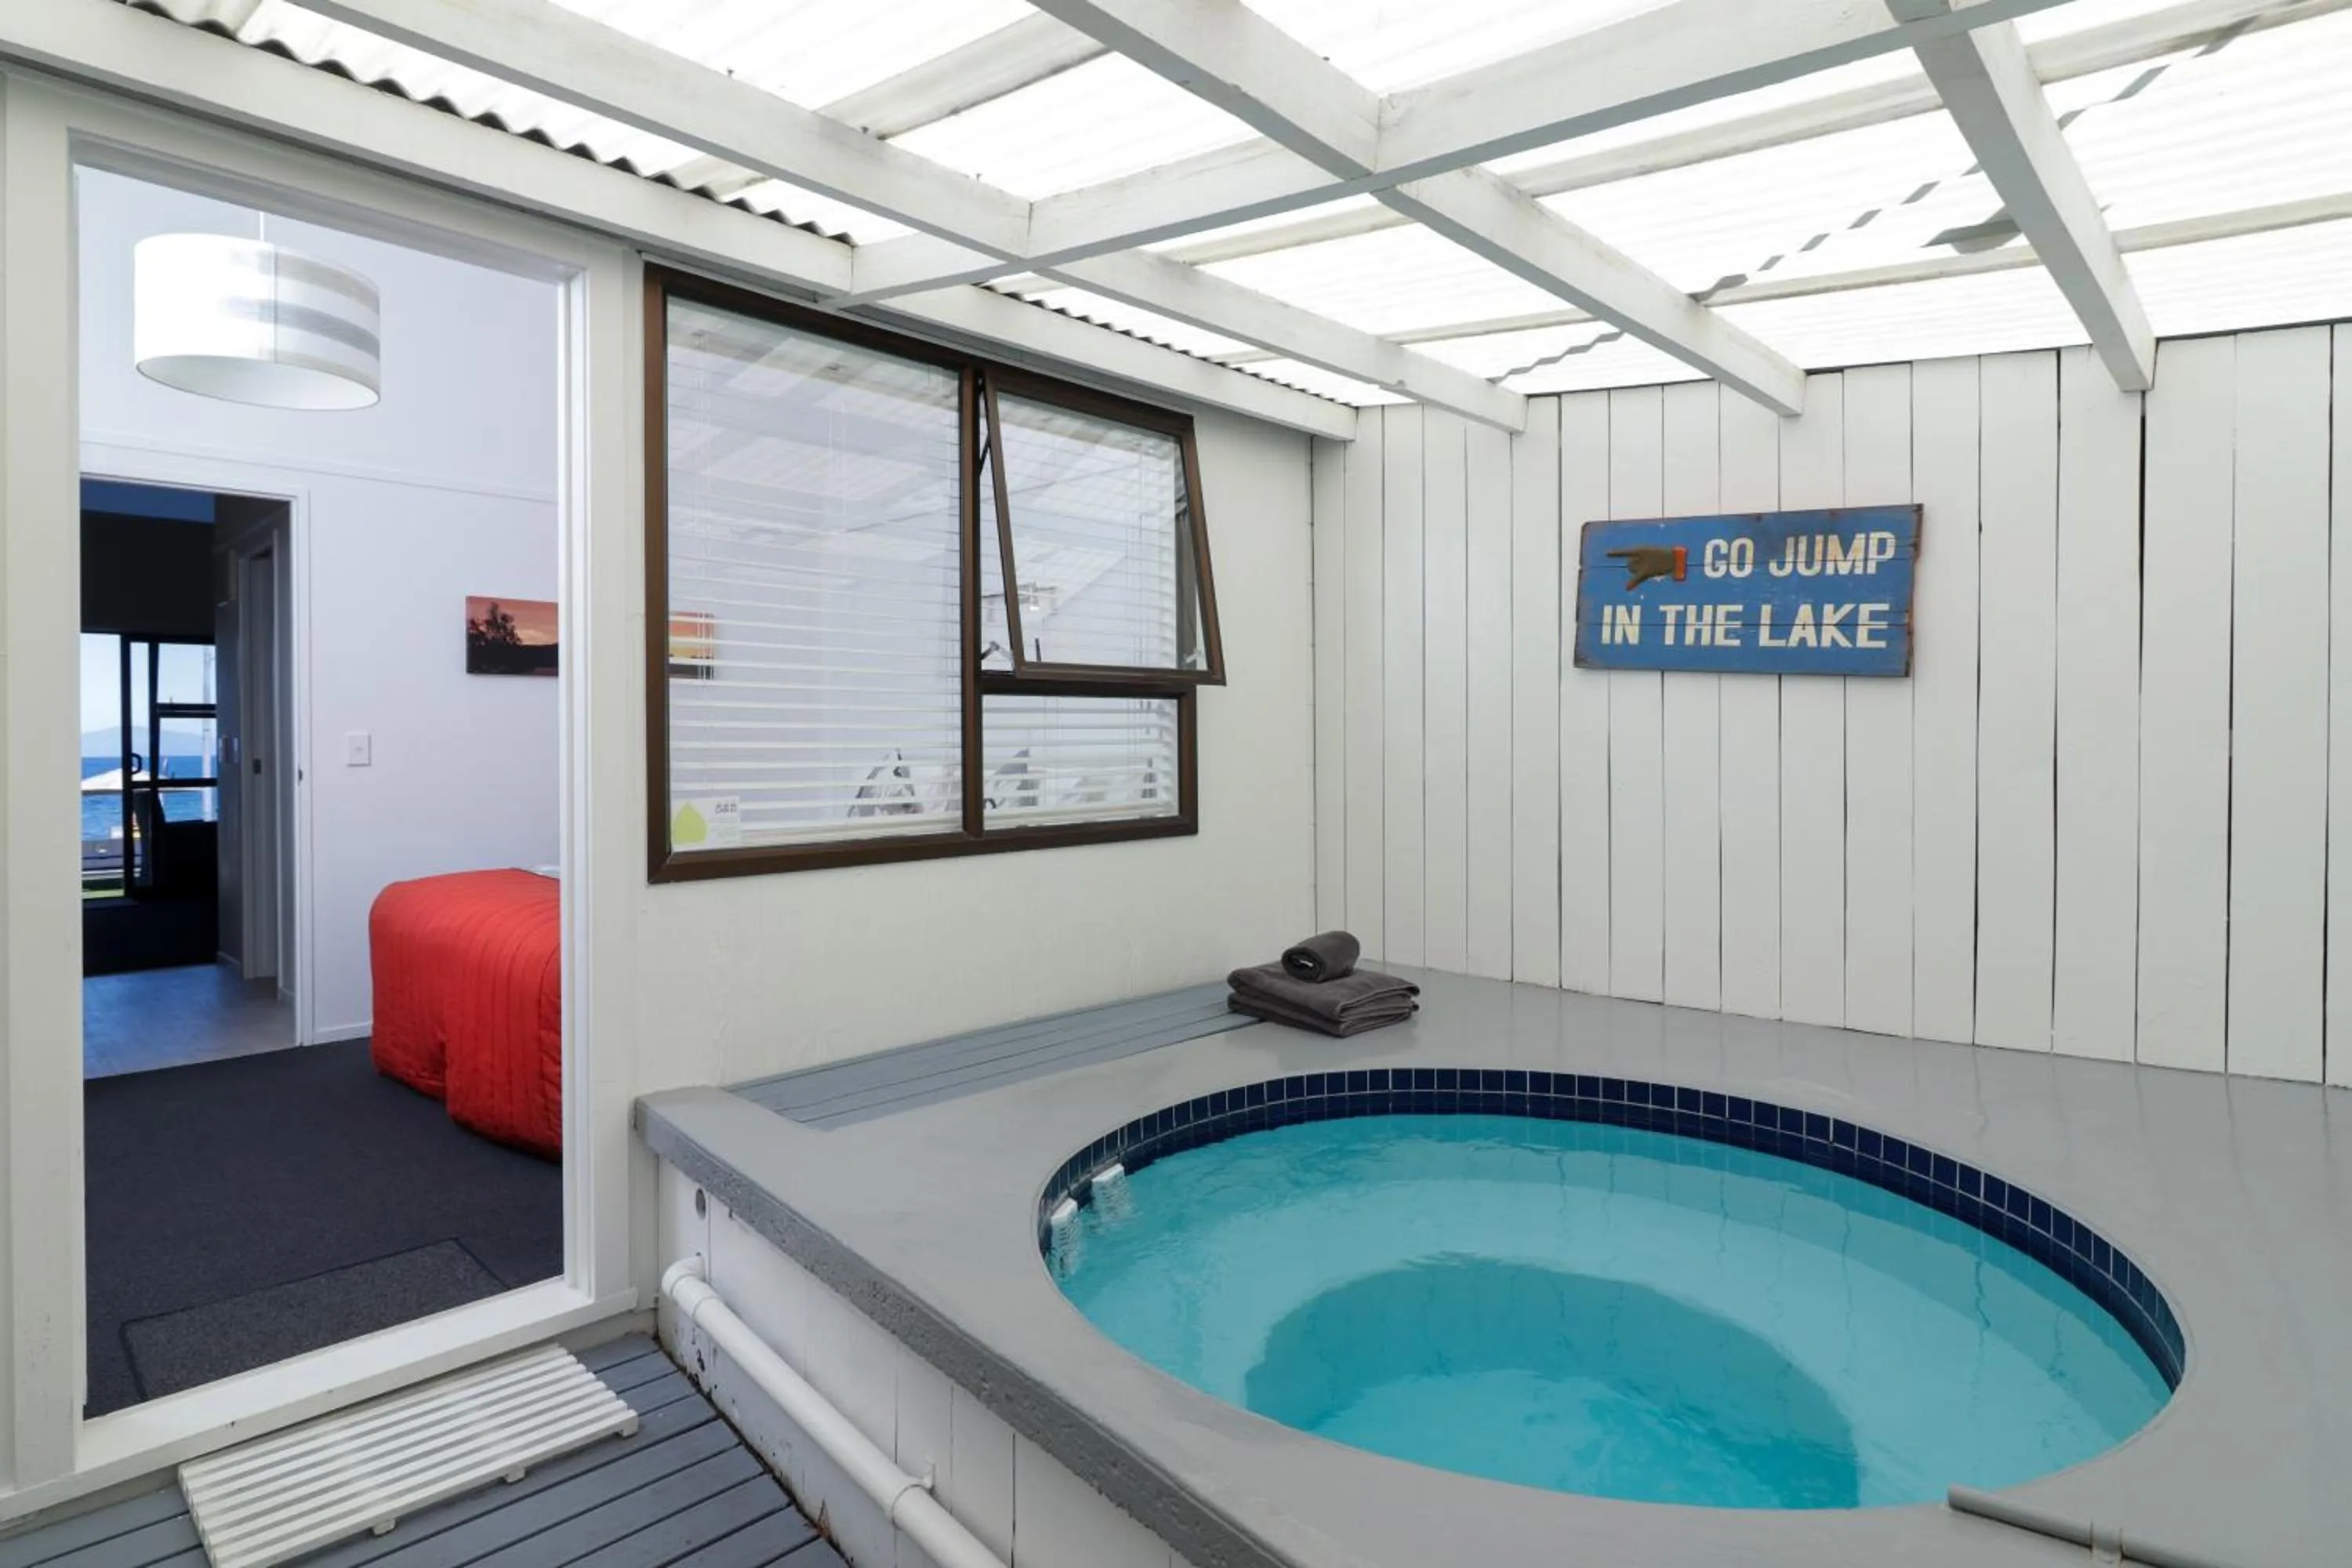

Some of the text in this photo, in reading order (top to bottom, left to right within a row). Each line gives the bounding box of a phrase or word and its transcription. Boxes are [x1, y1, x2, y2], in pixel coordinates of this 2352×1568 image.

[1704, 532, 1896, 579] GO JUMP
[1602, 603, 1890, 648] IN THE LAKE
